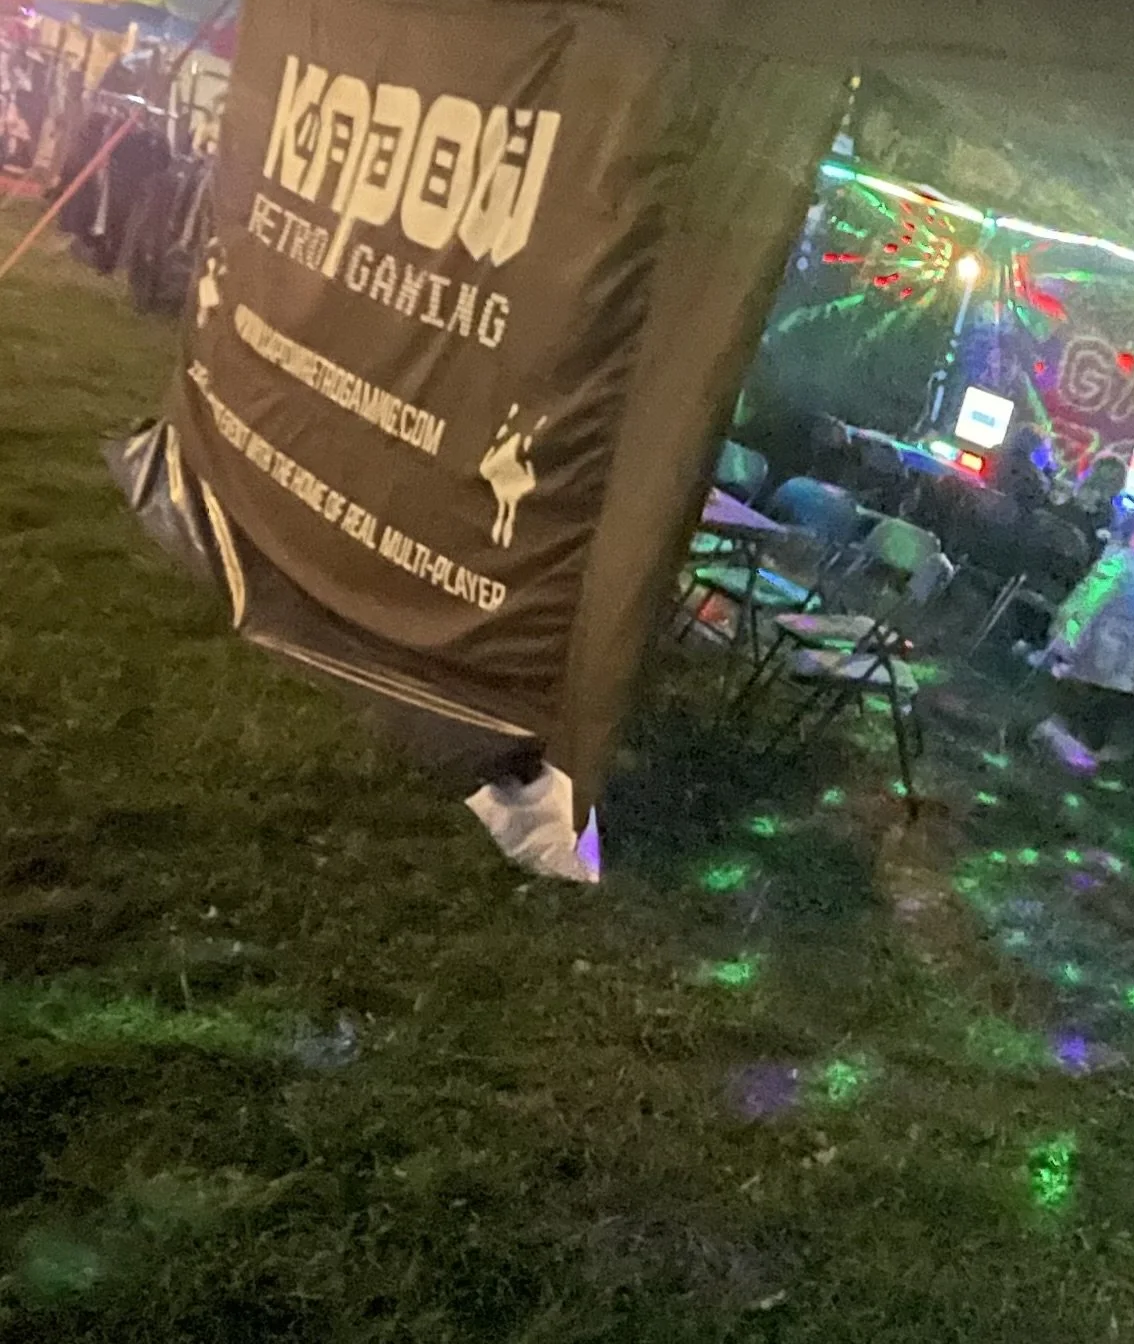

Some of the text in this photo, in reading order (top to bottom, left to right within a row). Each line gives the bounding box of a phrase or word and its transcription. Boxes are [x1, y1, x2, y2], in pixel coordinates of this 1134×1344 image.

[263, 54, 562, 279] KAPOW
[248, 192, 511, 348] RETRO GAMING
[340, 501, 379, 551] REAL
[377, 524, 507, 613] MULTI-PLAYER
